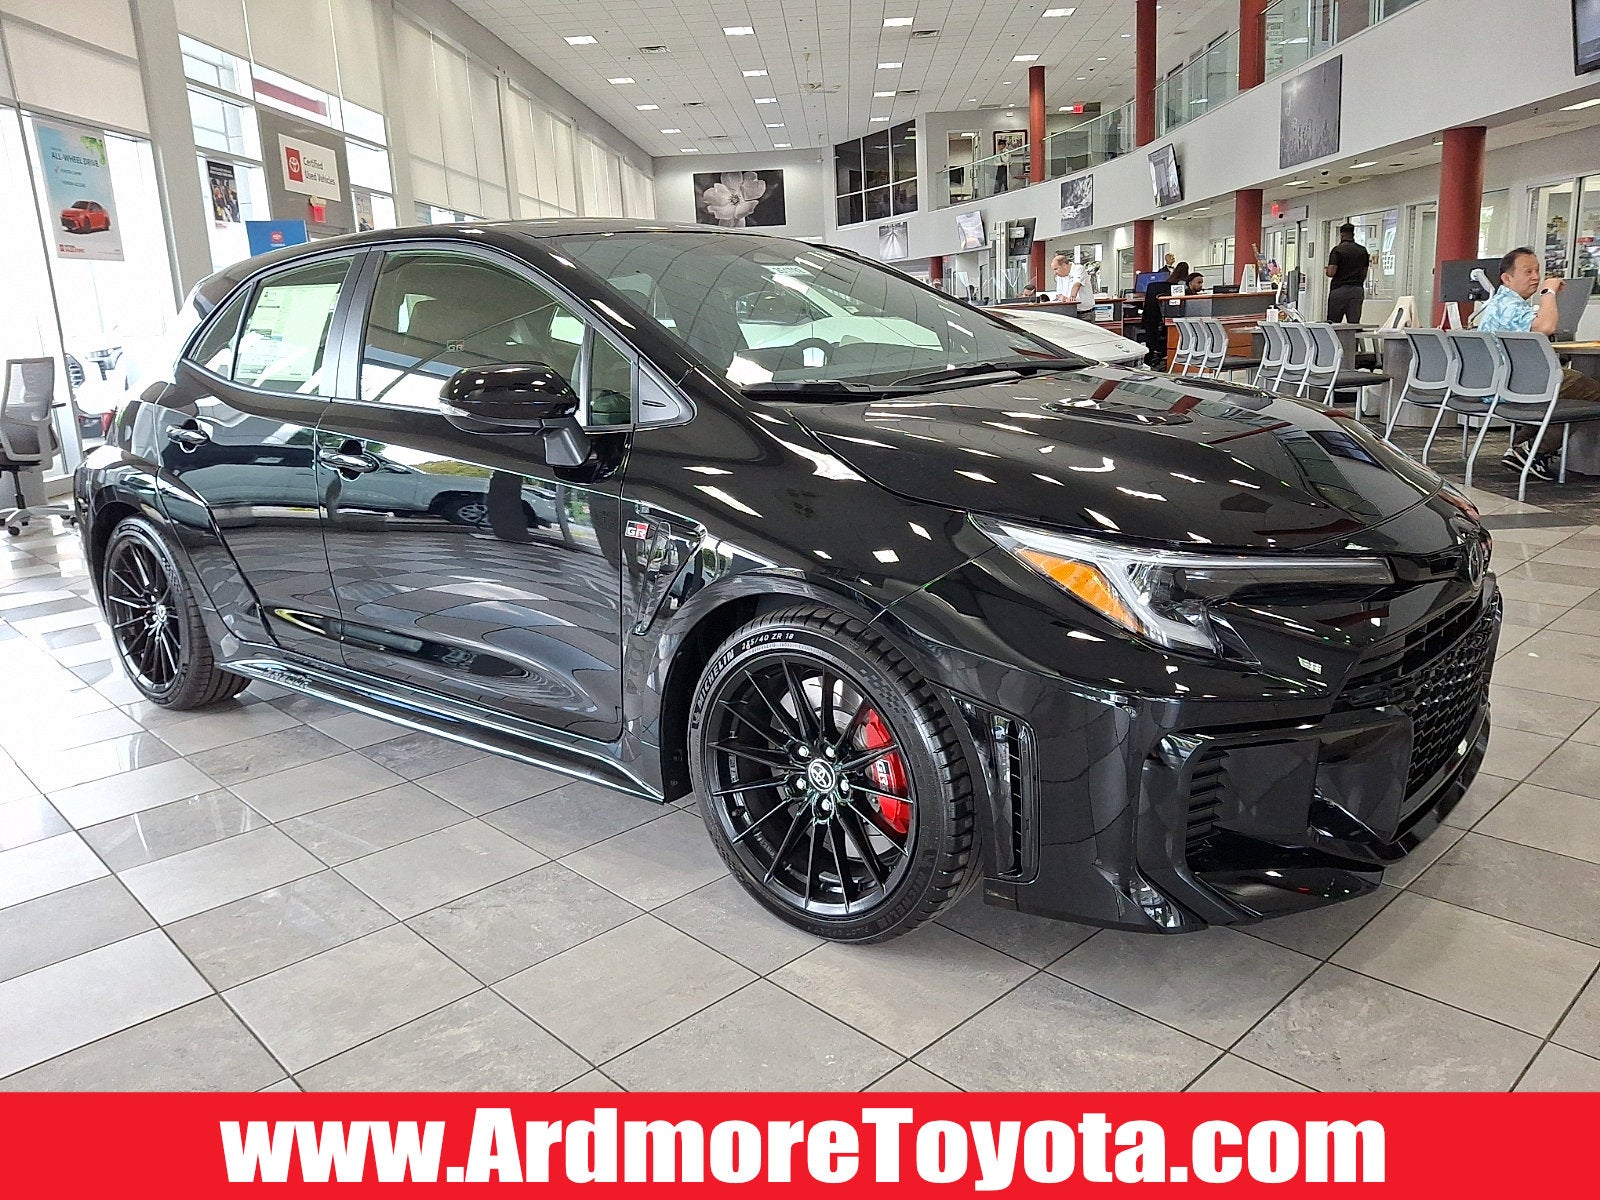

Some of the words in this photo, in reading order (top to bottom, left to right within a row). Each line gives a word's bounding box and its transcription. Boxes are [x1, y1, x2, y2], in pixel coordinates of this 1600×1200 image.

[51, 152, 83, 165] ALL-WHEEL
[303, 157, 324, 170] Certified
[304, 169, 317, 181] Used
[317, 172, 336, 186] Vehicles
[625, 525, 648, 540] GR
[771, 632, 782, 640] ZR
[785, 632, 795, 640] 18
[697, 649, 735, 709] MICHELIN
